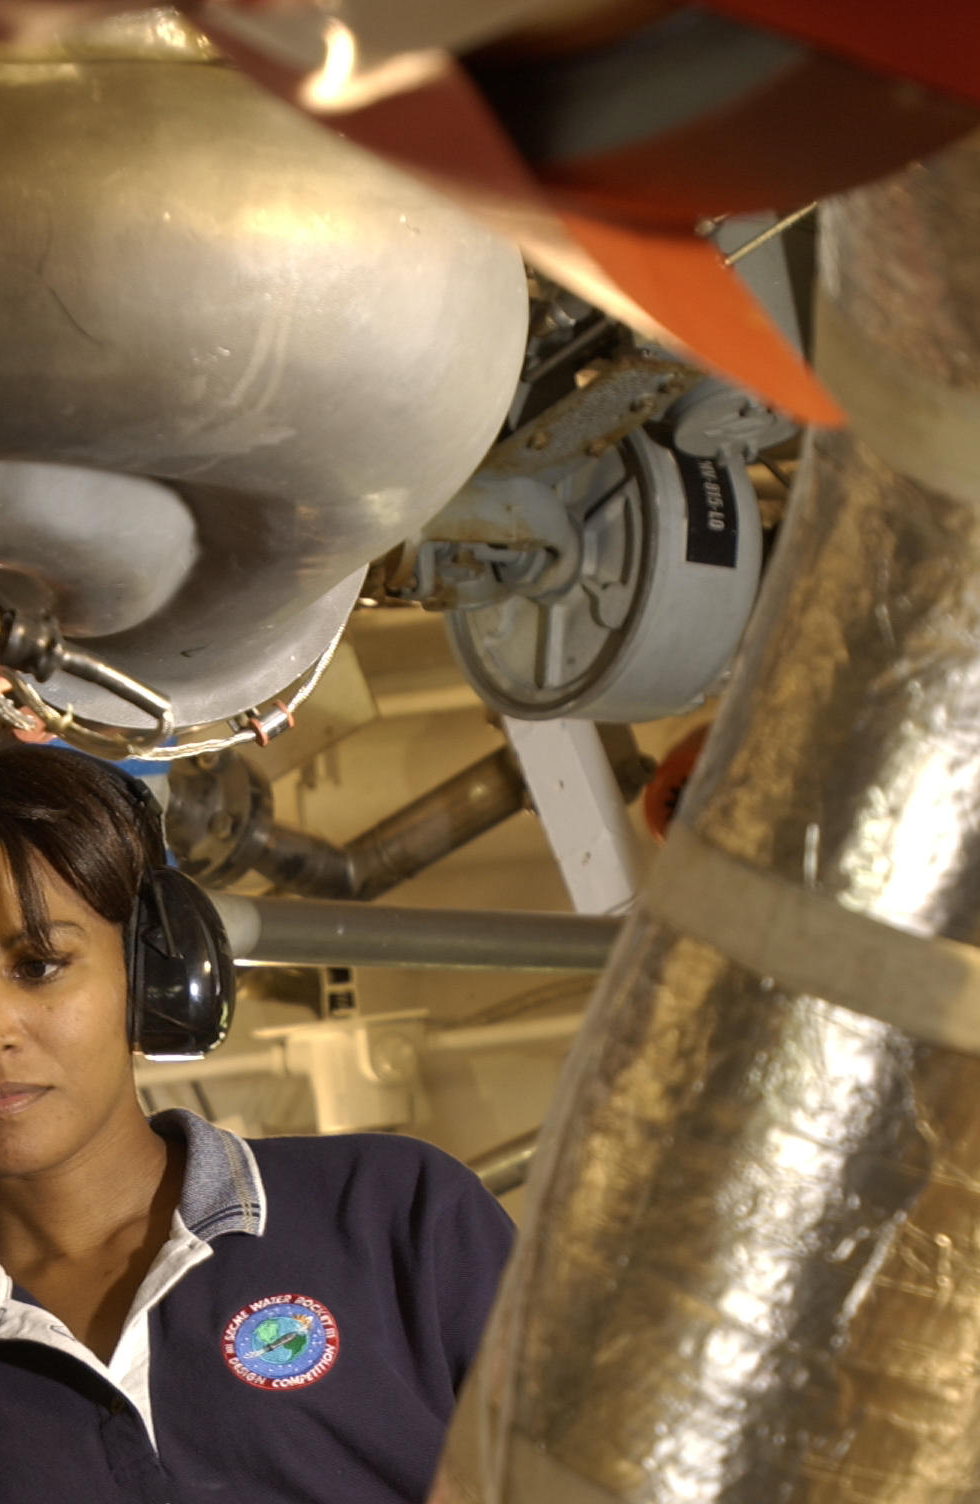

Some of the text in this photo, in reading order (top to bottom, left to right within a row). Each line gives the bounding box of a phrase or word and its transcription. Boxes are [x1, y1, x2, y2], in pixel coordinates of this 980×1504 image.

[249, 1294, 292, 1312] WATER
[294, 1296, 334, 1326] ROCKET
[228, 1344, 336, 1388] DESIGN COMPETITION
